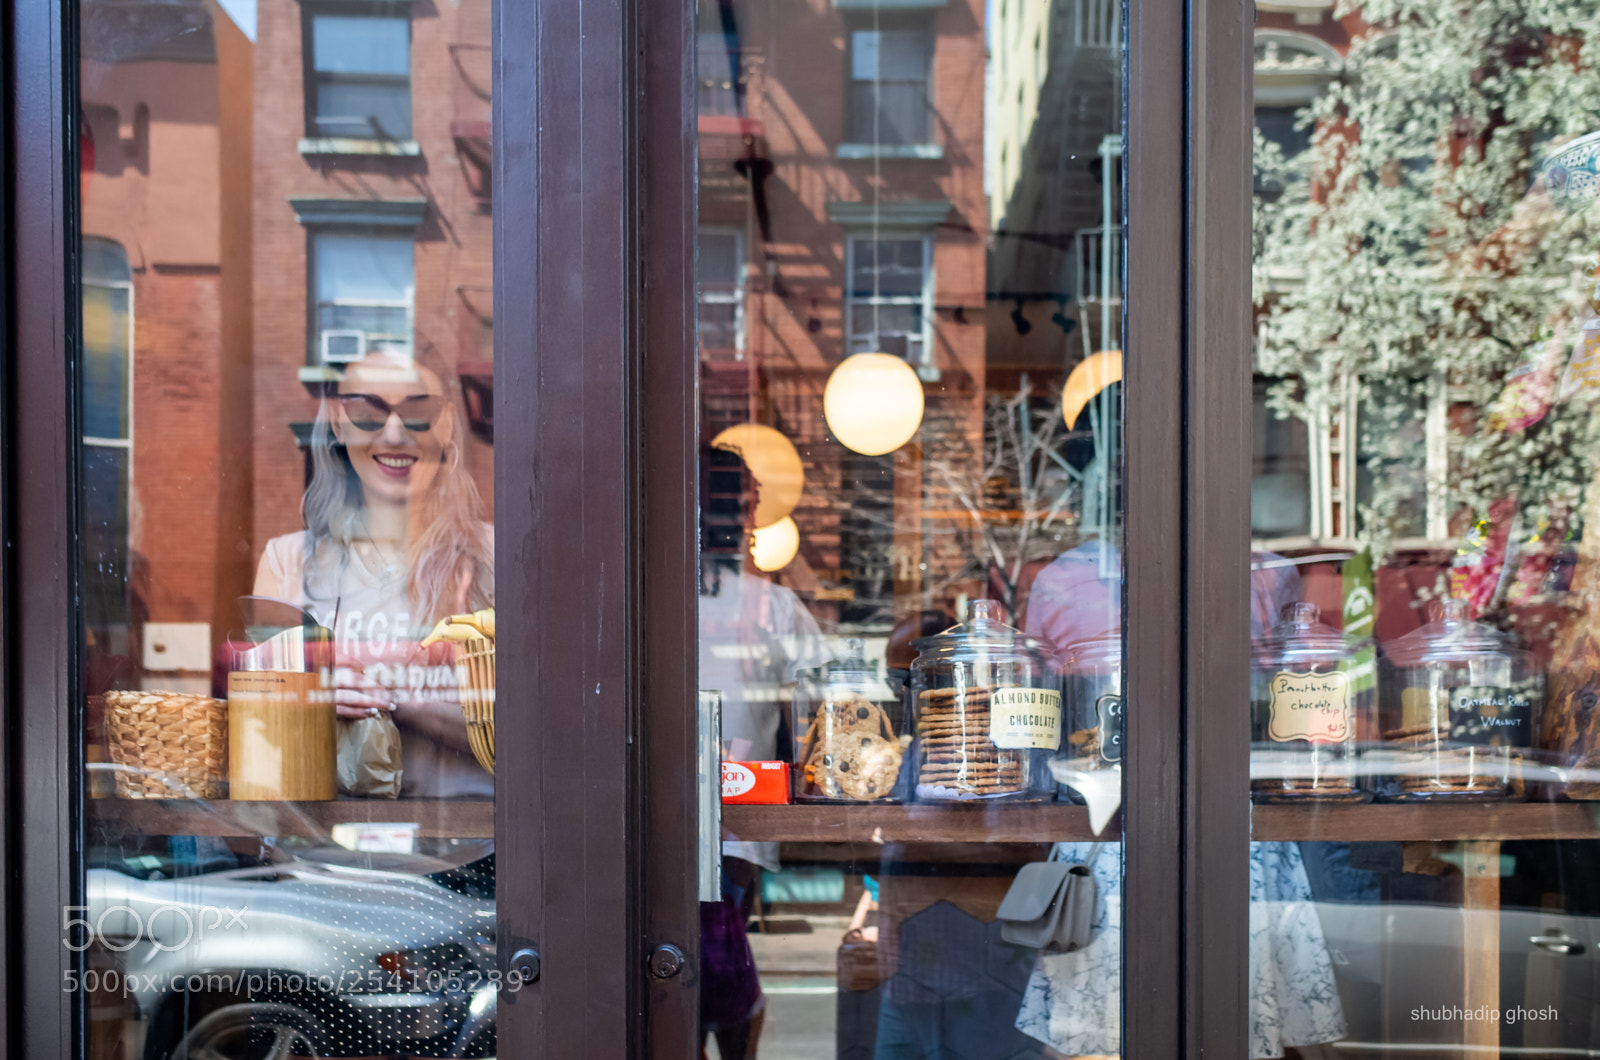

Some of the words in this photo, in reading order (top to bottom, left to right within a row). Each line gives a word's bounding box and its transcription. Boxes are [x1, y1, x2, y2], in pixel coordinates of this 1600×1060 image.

[994, 692, 1036, 705] ALMOND
[1459, 696, 1503, 708] OATMEAL
[1291, 699, 1331, 711] chocolate
[1009, 715, 1055, 729] CHOCOLATE
[1480, 716, 1522, 728] WALNUT
